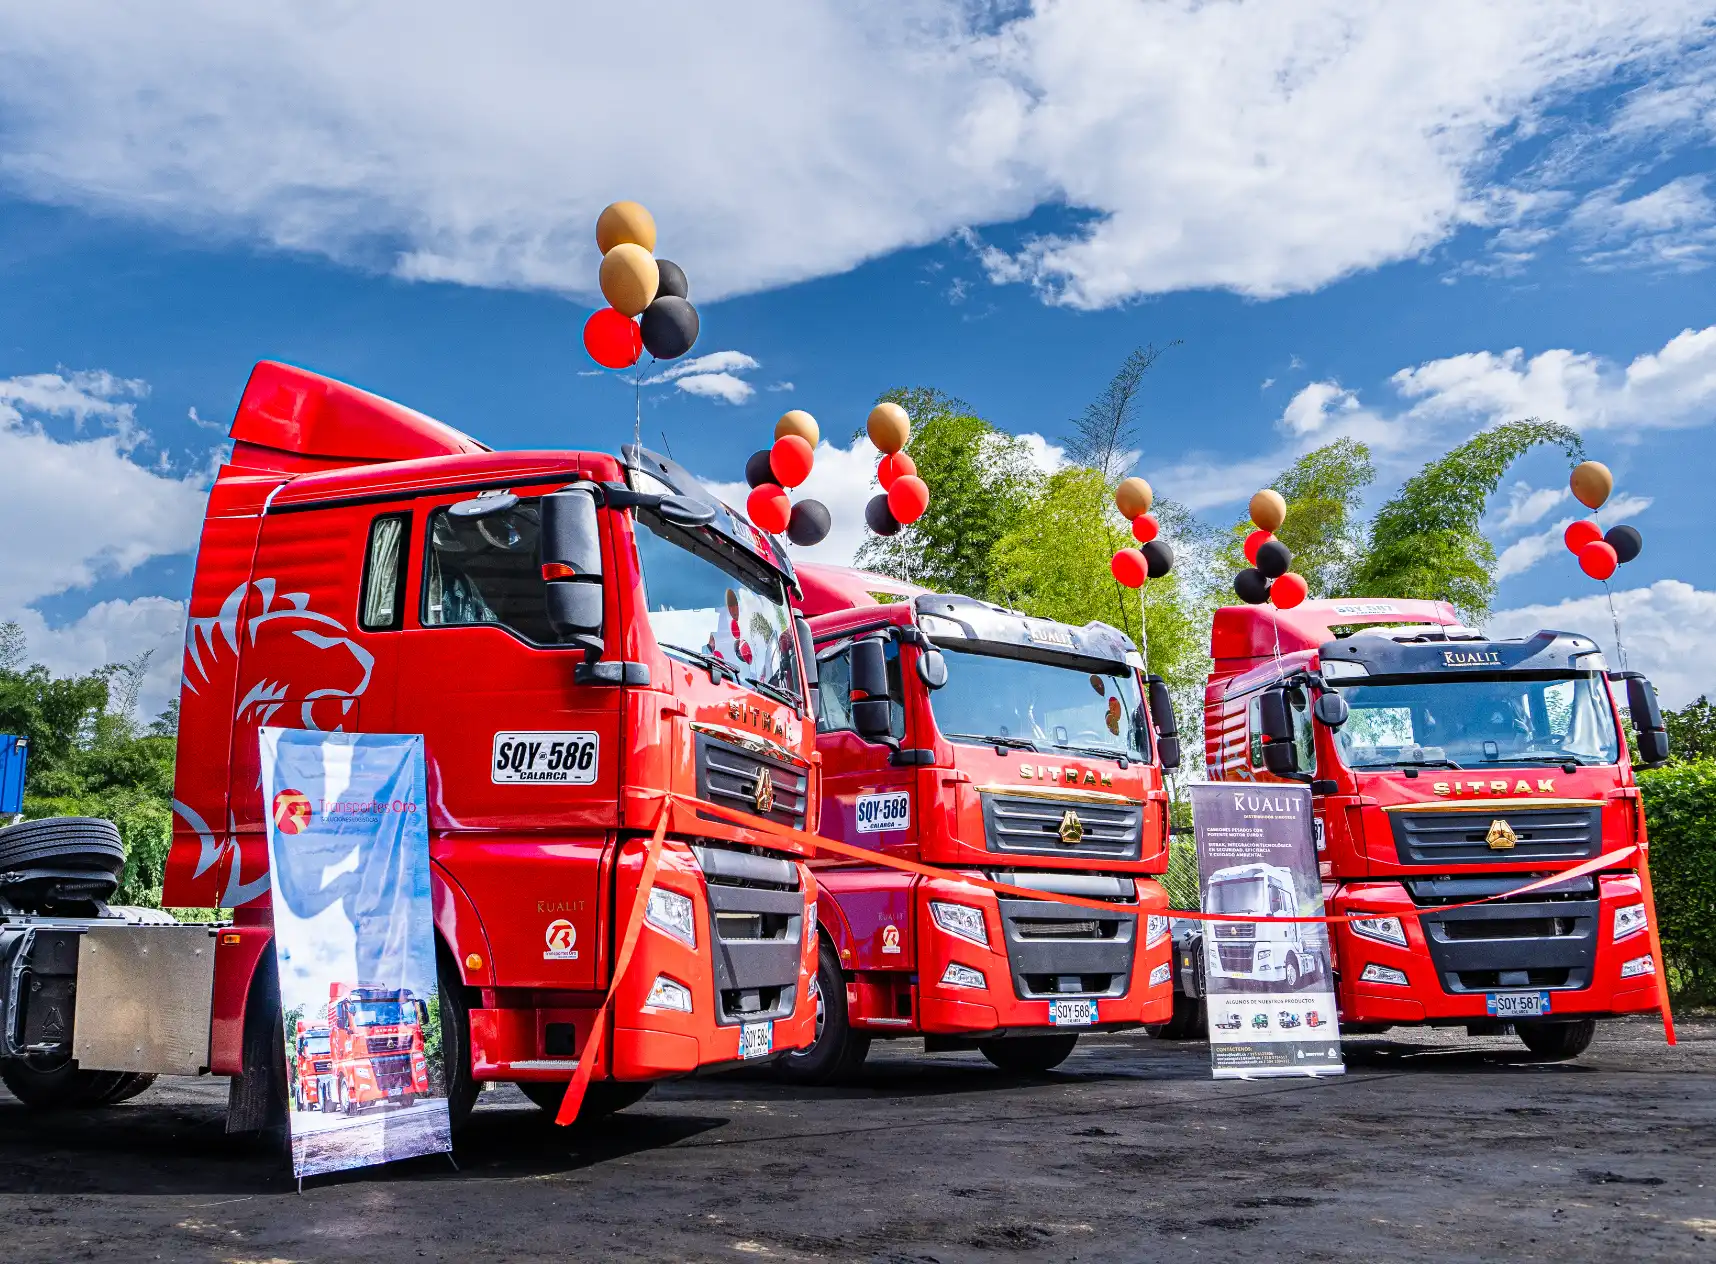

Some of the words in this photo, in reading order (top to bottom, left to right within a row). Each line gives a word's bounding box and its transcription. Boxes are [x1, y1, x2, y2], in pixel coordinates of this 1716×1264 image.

[1443, 651, 1499, 663] KUALIT
[496, 741, 542, 773] SQY
[547, 741, 595, 771] 586
[519, 771, 568, 780] CALARCA
[1019, 763, 1113, 788] SITRAK
[1432, 779, 1556, 796] SITRAK
[391, 800, 417, 813] Oro
[1233, 792, 1302, 812] KUALIT
[536, 900, 585, 913] KUALIT
[1519, 996, 1539, 1010] 587
